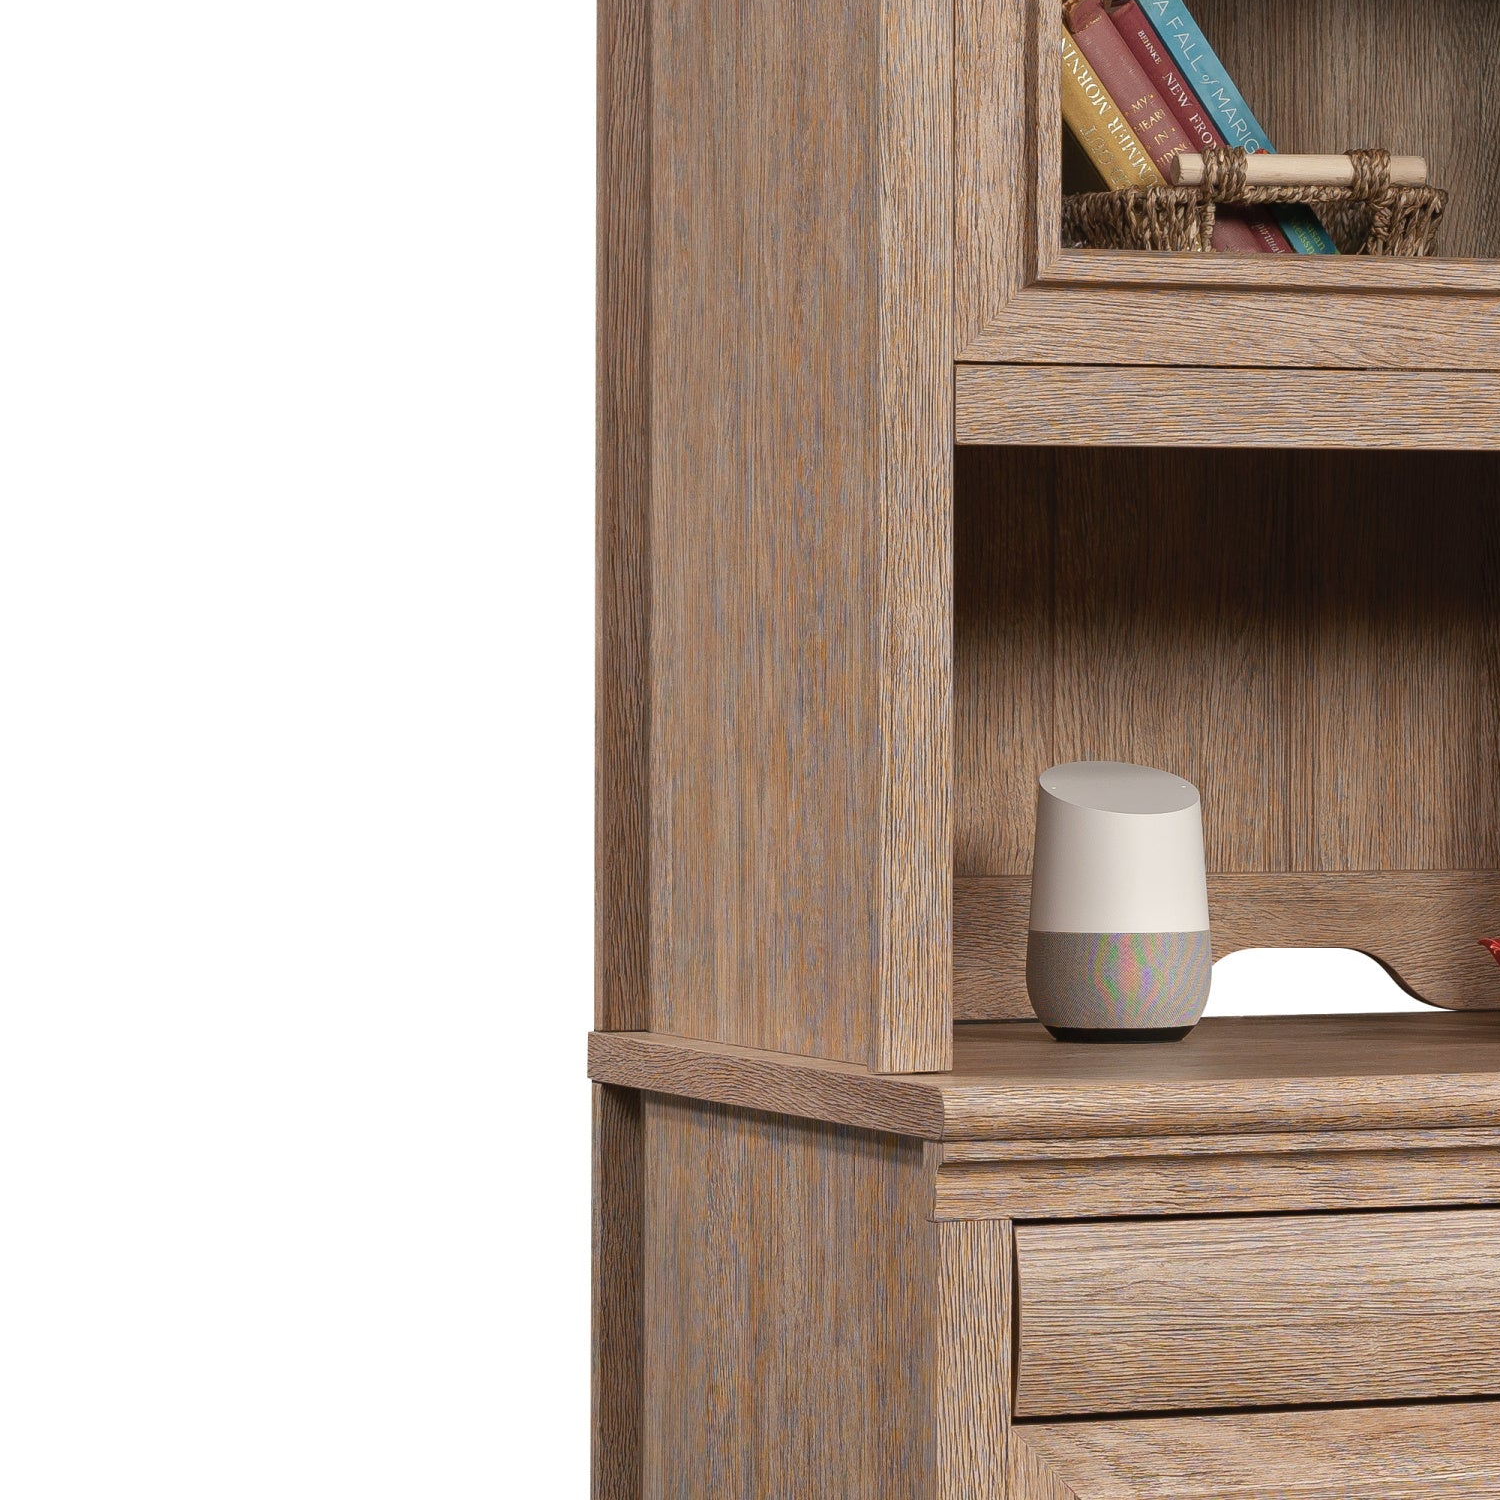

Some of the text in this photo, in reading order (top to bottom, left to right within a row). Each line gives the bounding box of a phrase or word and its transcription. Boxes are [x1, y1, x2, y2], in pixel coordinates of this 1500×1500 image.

[1136, 29, 1162, 65] BEHNKE
[1152, 0, 1169, 16] A
[1166, 16, 1204, 72] FALL
[1201, 74, 1219, 86] of
[1131, 95, 1150, 114] MY
[1162, 72, 1193, 109] NEW
[1154, 130, 1169, 146] IN
